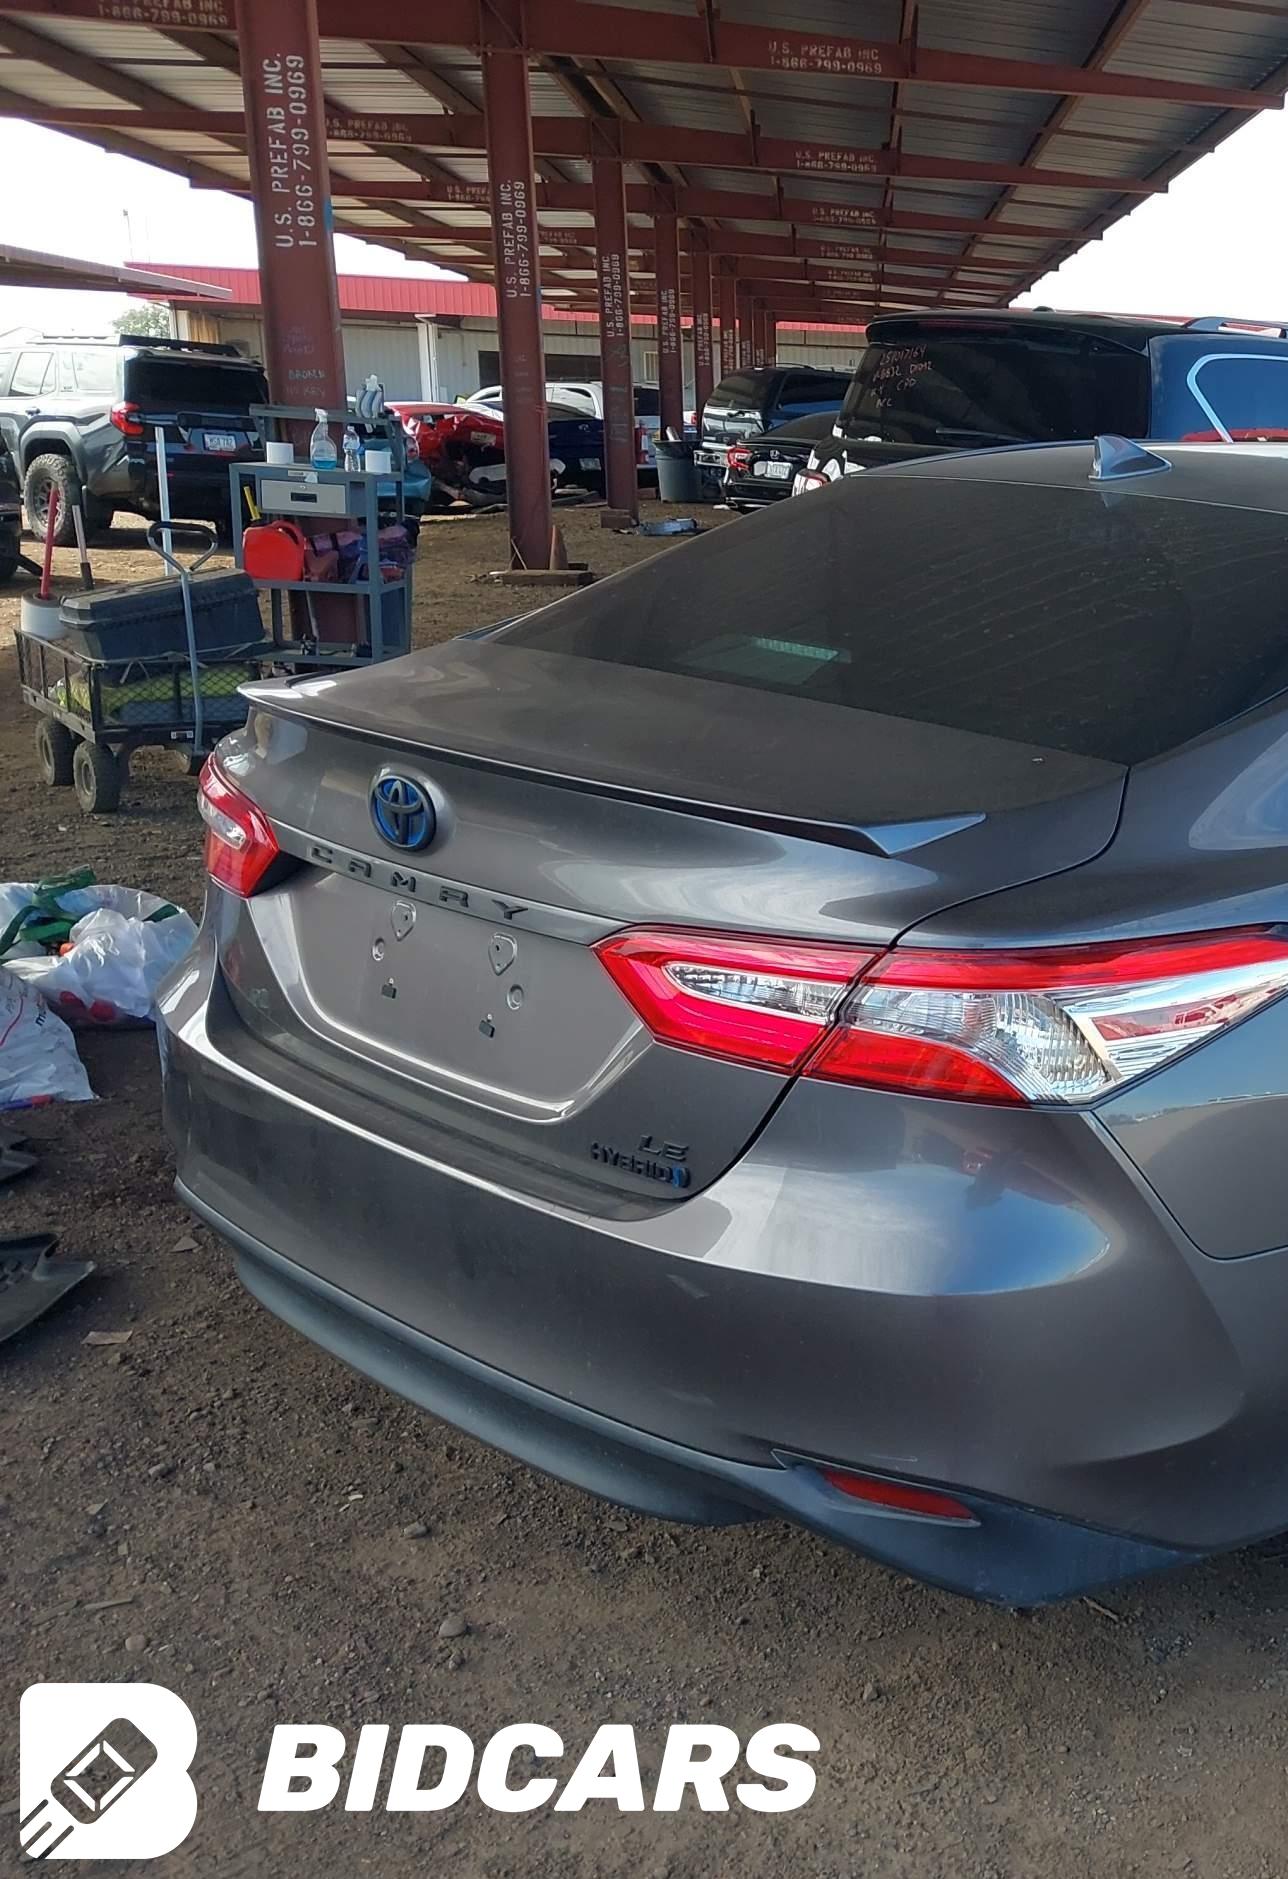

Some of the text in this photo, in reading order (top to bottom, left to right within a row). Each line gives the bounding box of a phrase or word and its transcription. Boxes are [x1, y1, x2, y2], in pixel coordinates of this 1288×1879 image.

[801, 45, 852, 60] PREFAB
[263, 53, 295, 248] U.S. PREFAB INC.
[286, 55, 318, 247] 1-866-799-0969
[503, 211, 515, 265] PREFAB
[514, 181, 532, 297] 1-866-799-0969
[311, 846, 529, 920] CAMRY
[589, 1141, 674, 1184] HYBRID
[638, 1133, 690, 1162] LE
